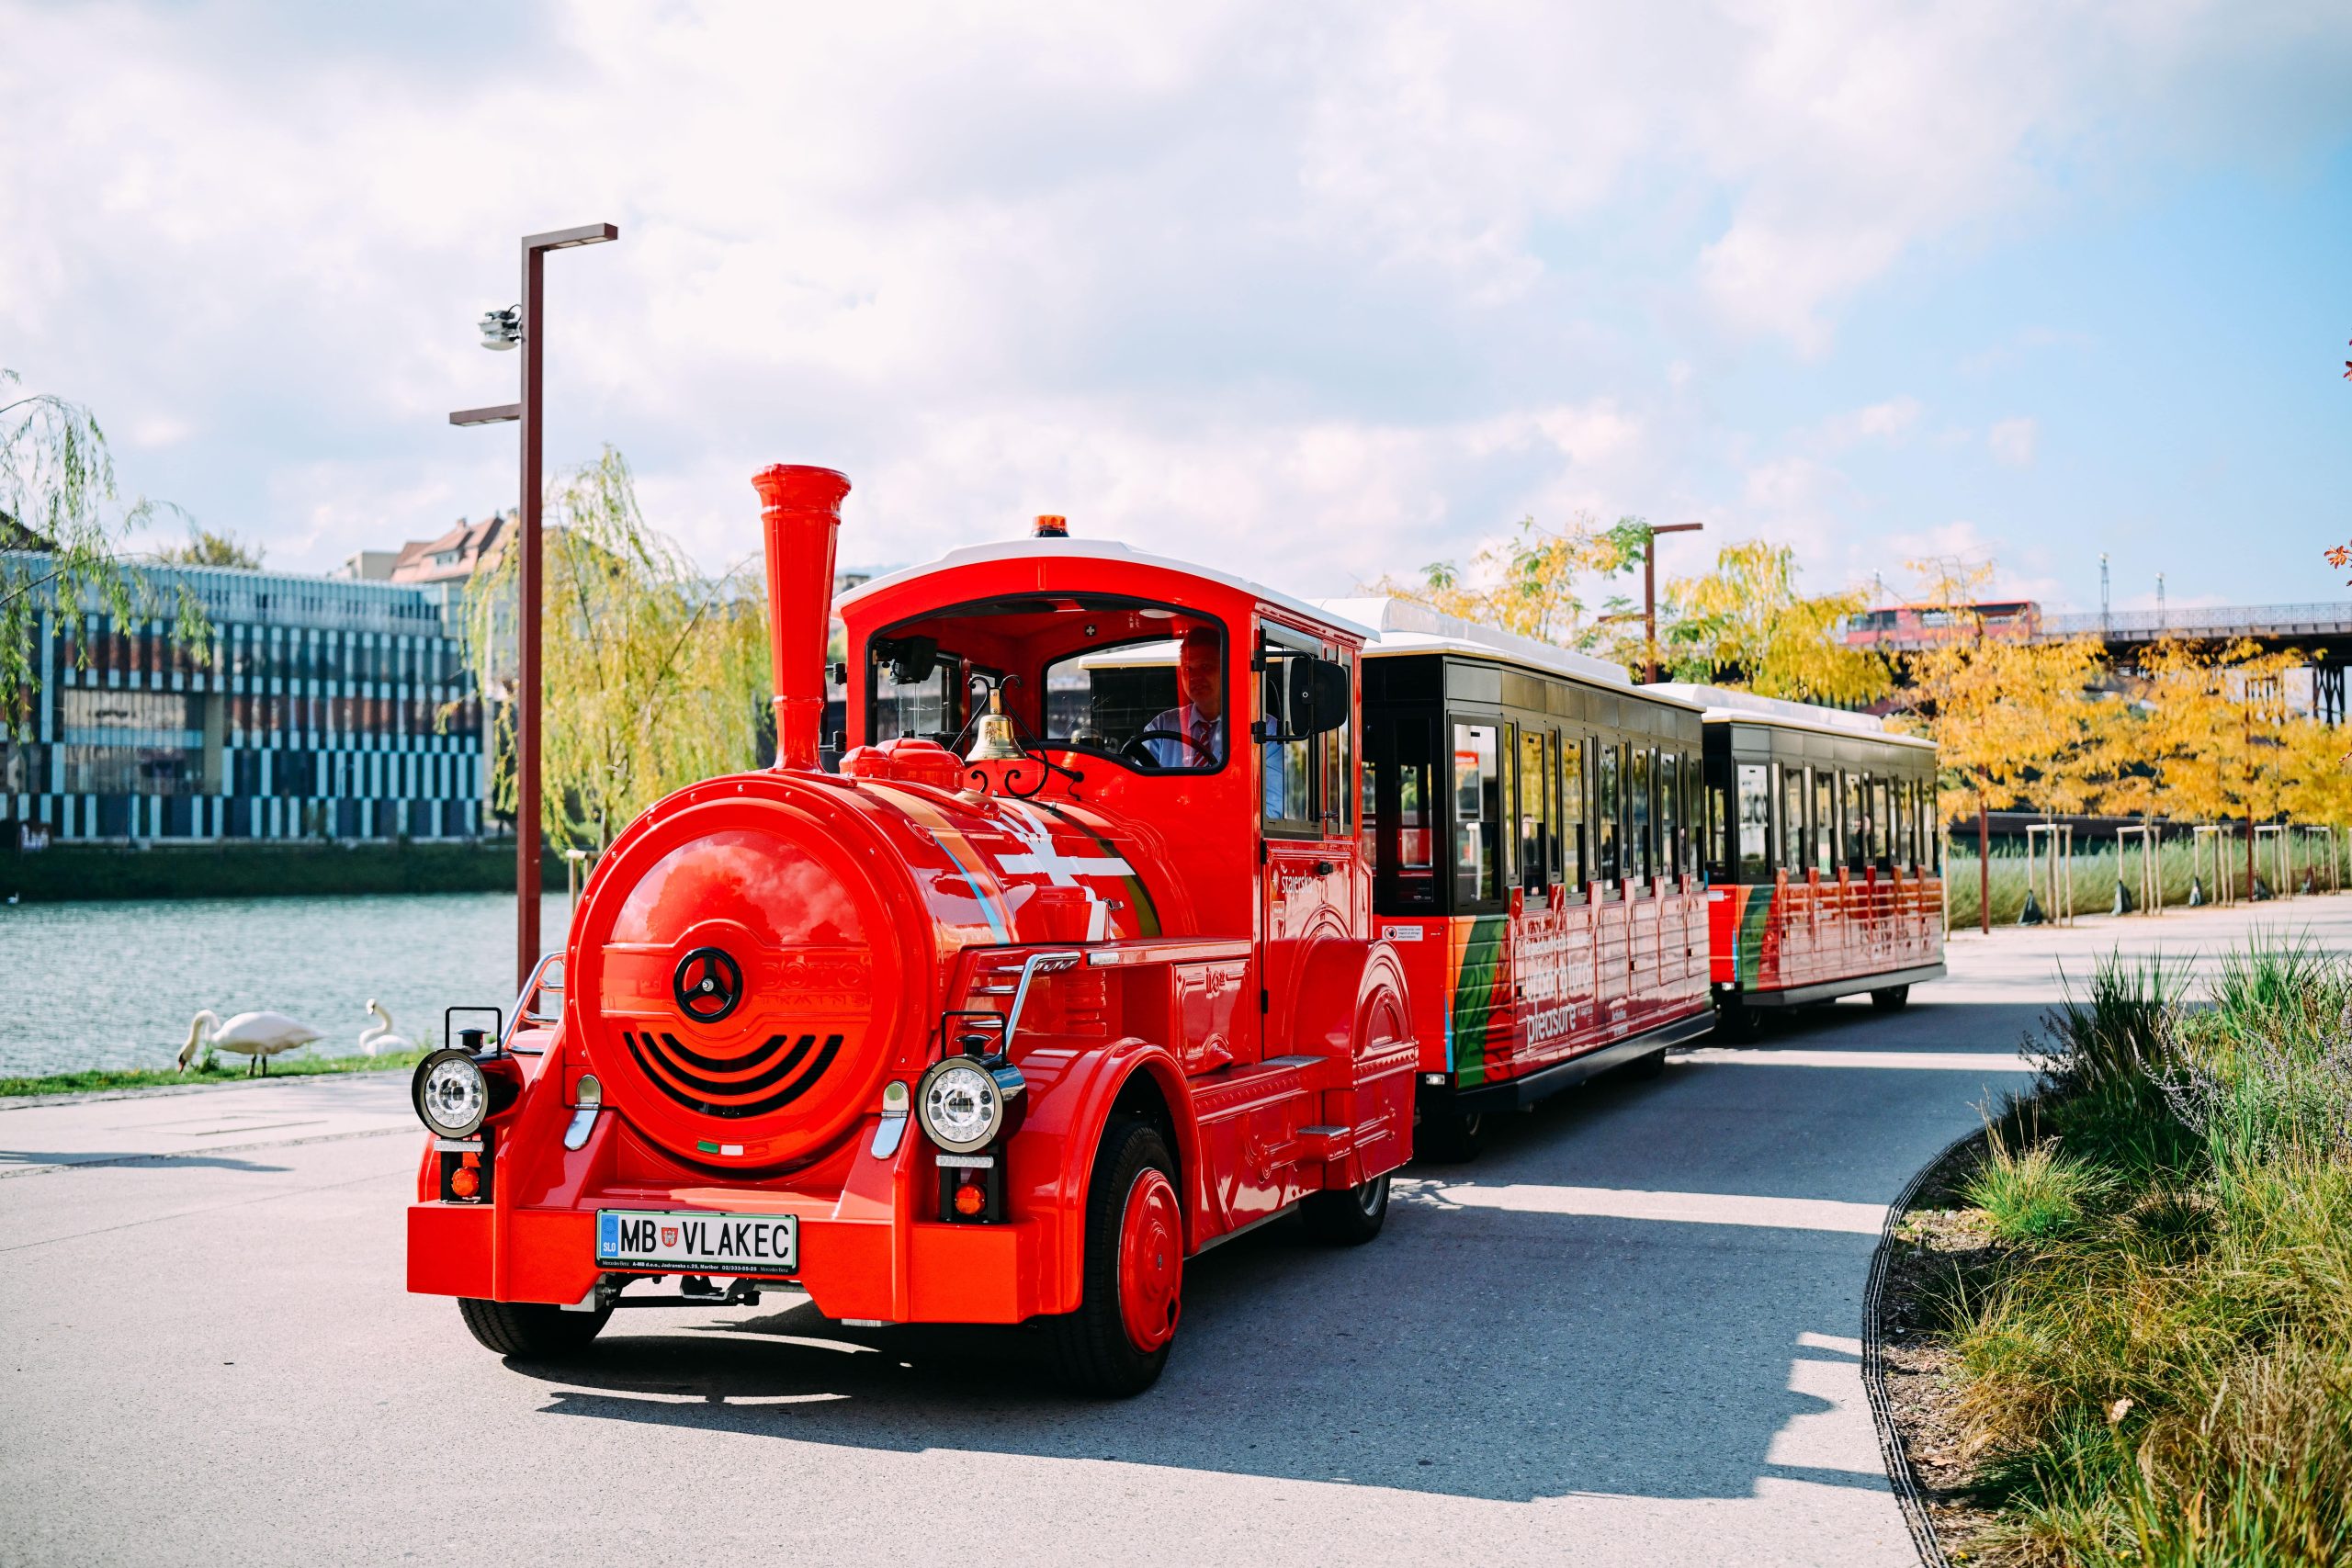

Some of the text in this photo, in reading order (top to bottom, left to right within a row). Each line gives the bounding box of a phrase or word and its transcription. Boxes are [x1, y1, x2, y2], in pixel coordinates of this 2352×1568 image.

[1526, 999, 1577, 1052] pleasure
[603, 1241, 616, 1253] SLO
[621, 1219, 789, 1258] MB VLAKEC
